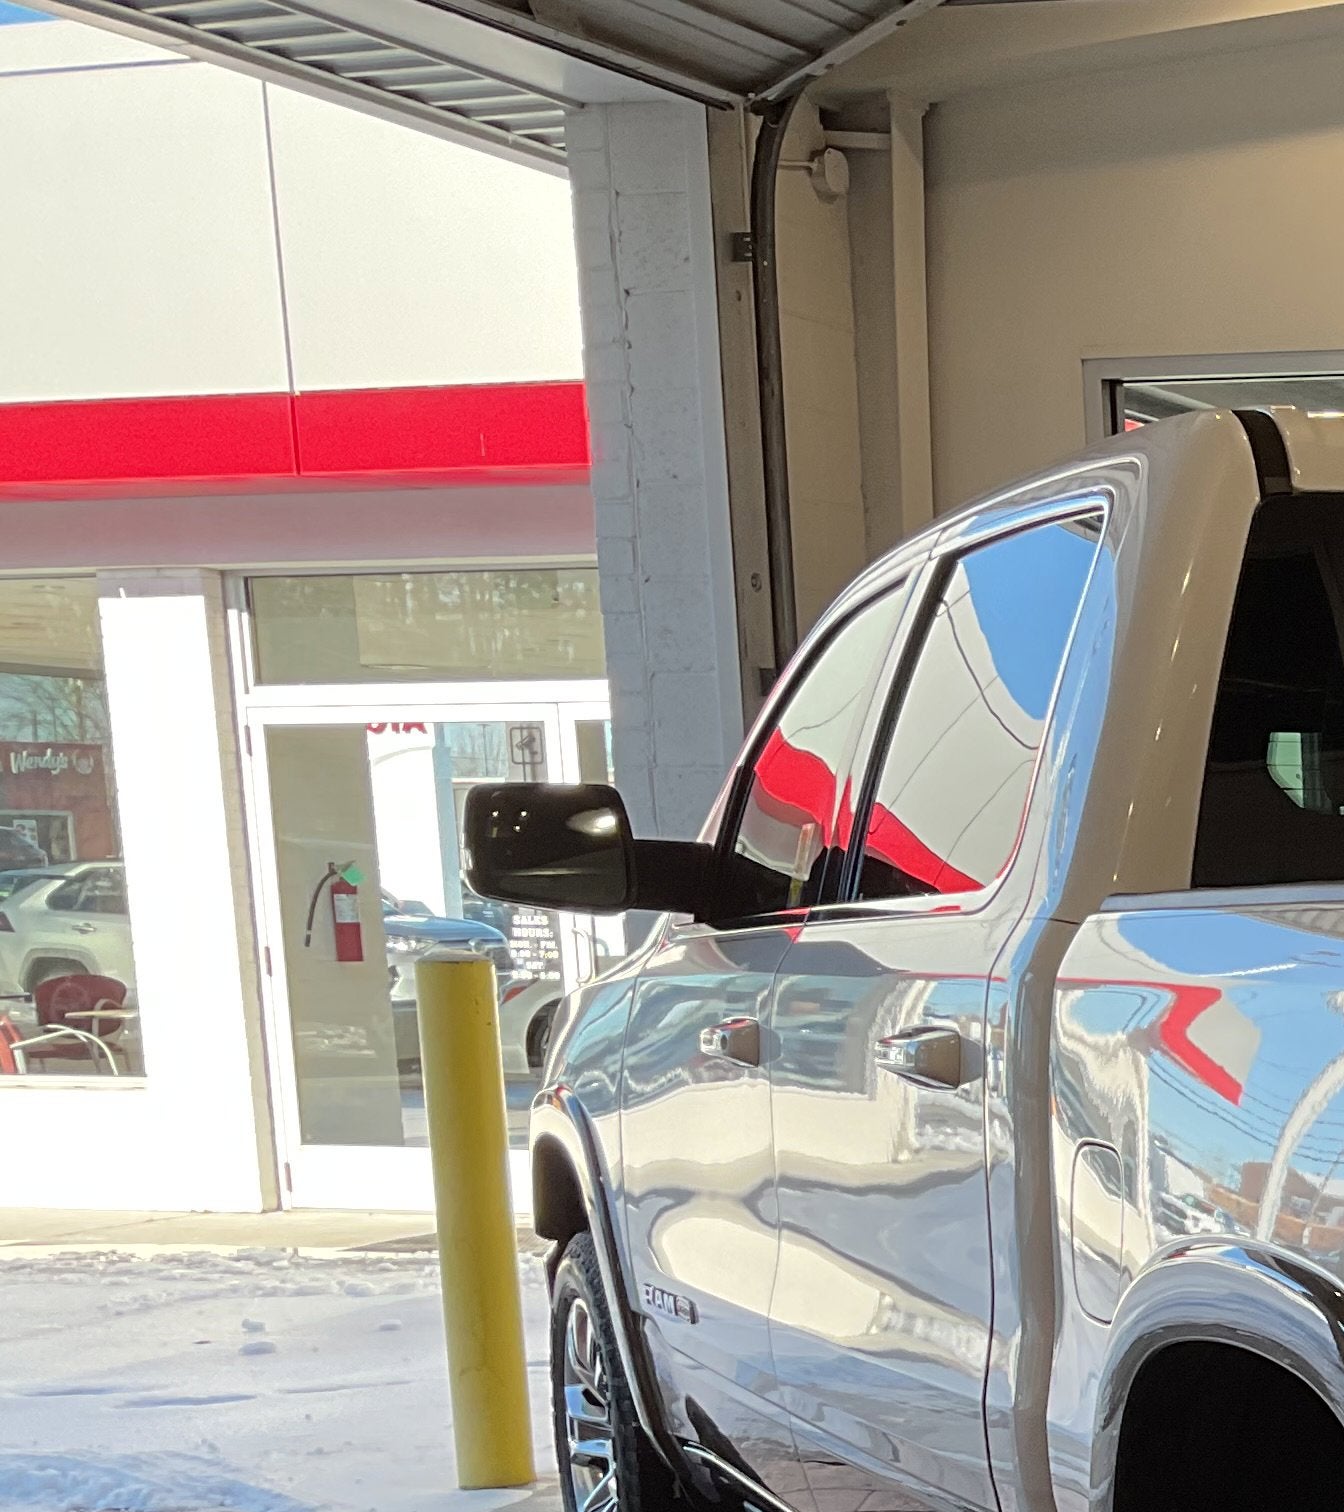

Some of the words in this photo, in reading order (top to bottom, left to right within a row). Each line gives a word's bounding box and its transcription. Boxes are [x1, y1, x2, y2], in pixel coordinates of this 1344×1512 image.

[10, 748, 68, 774] Wendy's
[512, 914, 549, 926] SALES
[512, 927, 554, 938] HOURS:
